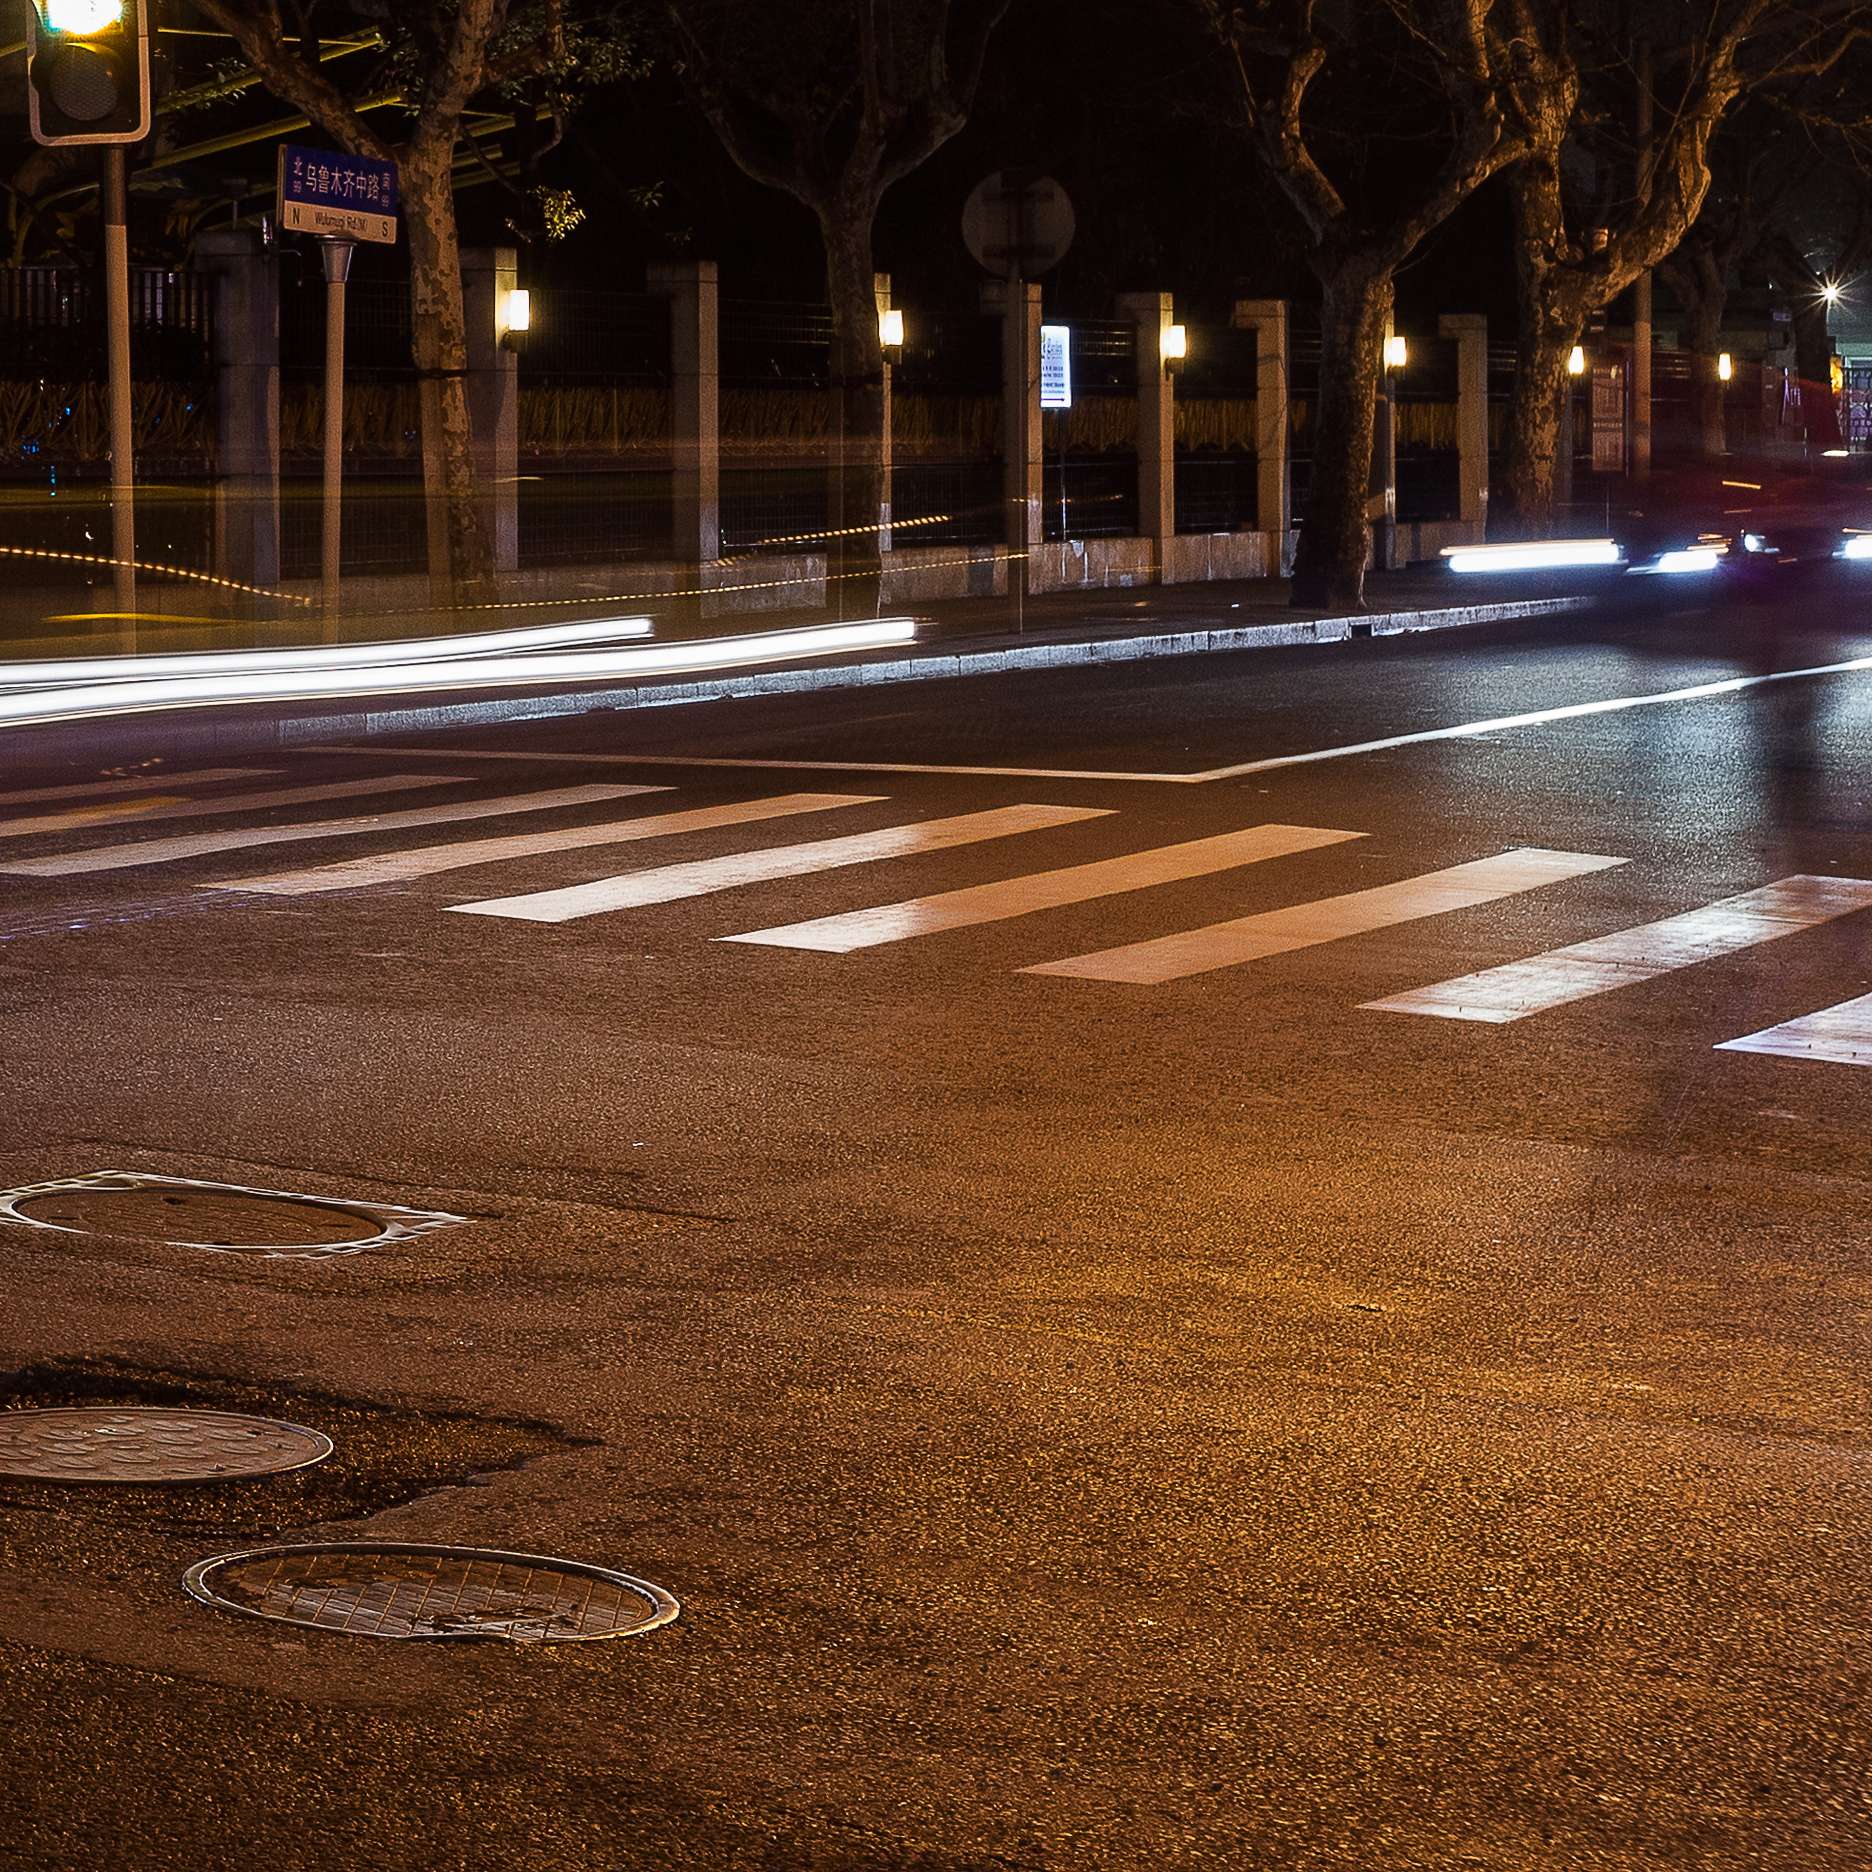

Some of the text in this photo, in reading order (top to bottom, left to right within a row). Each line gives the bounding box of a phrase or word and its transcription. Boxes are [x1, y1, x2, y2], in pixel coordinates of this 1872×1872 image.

[305, 161, 381, 201] 乌鲁木齐中路
[292, 207, 301, 225] N
[381, 221, 390, 238] S
